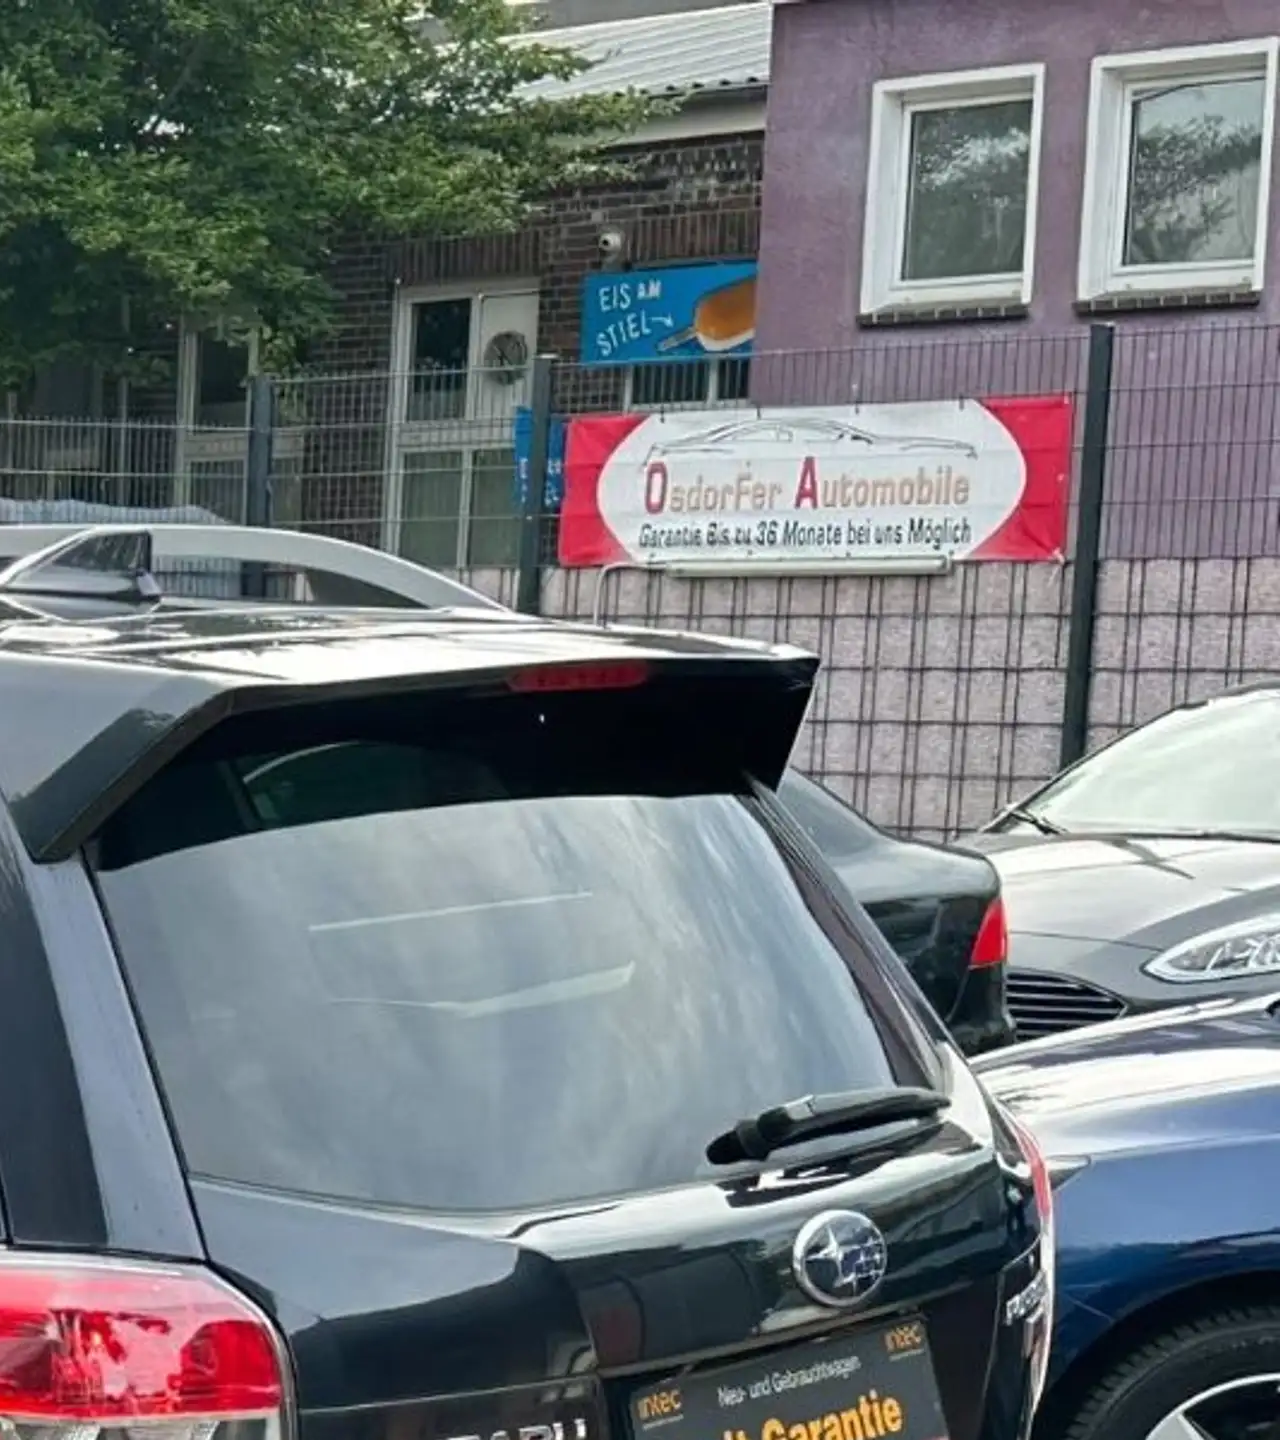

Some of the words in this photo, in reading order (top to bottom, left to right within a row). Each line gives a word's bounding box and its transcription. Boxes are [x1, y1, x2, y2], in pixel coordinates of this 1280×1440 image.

[599, 283, 631, 313] EIS
[637, 280, 661, 301] AM
[596, 313, 652, 357] STIEL
[645, 460, 783, 515] OsdorFer
[795, 456, 970, 510] Automobile
[639, 522, 702, 548] Garantie
[756, 520, 779, 546] 36
[782, 519, 842, 547] Monate
[847, 518, 871, 545] bei
[875, 524, 903, 545] uns
[908, 517, 972, 551] Möglich
